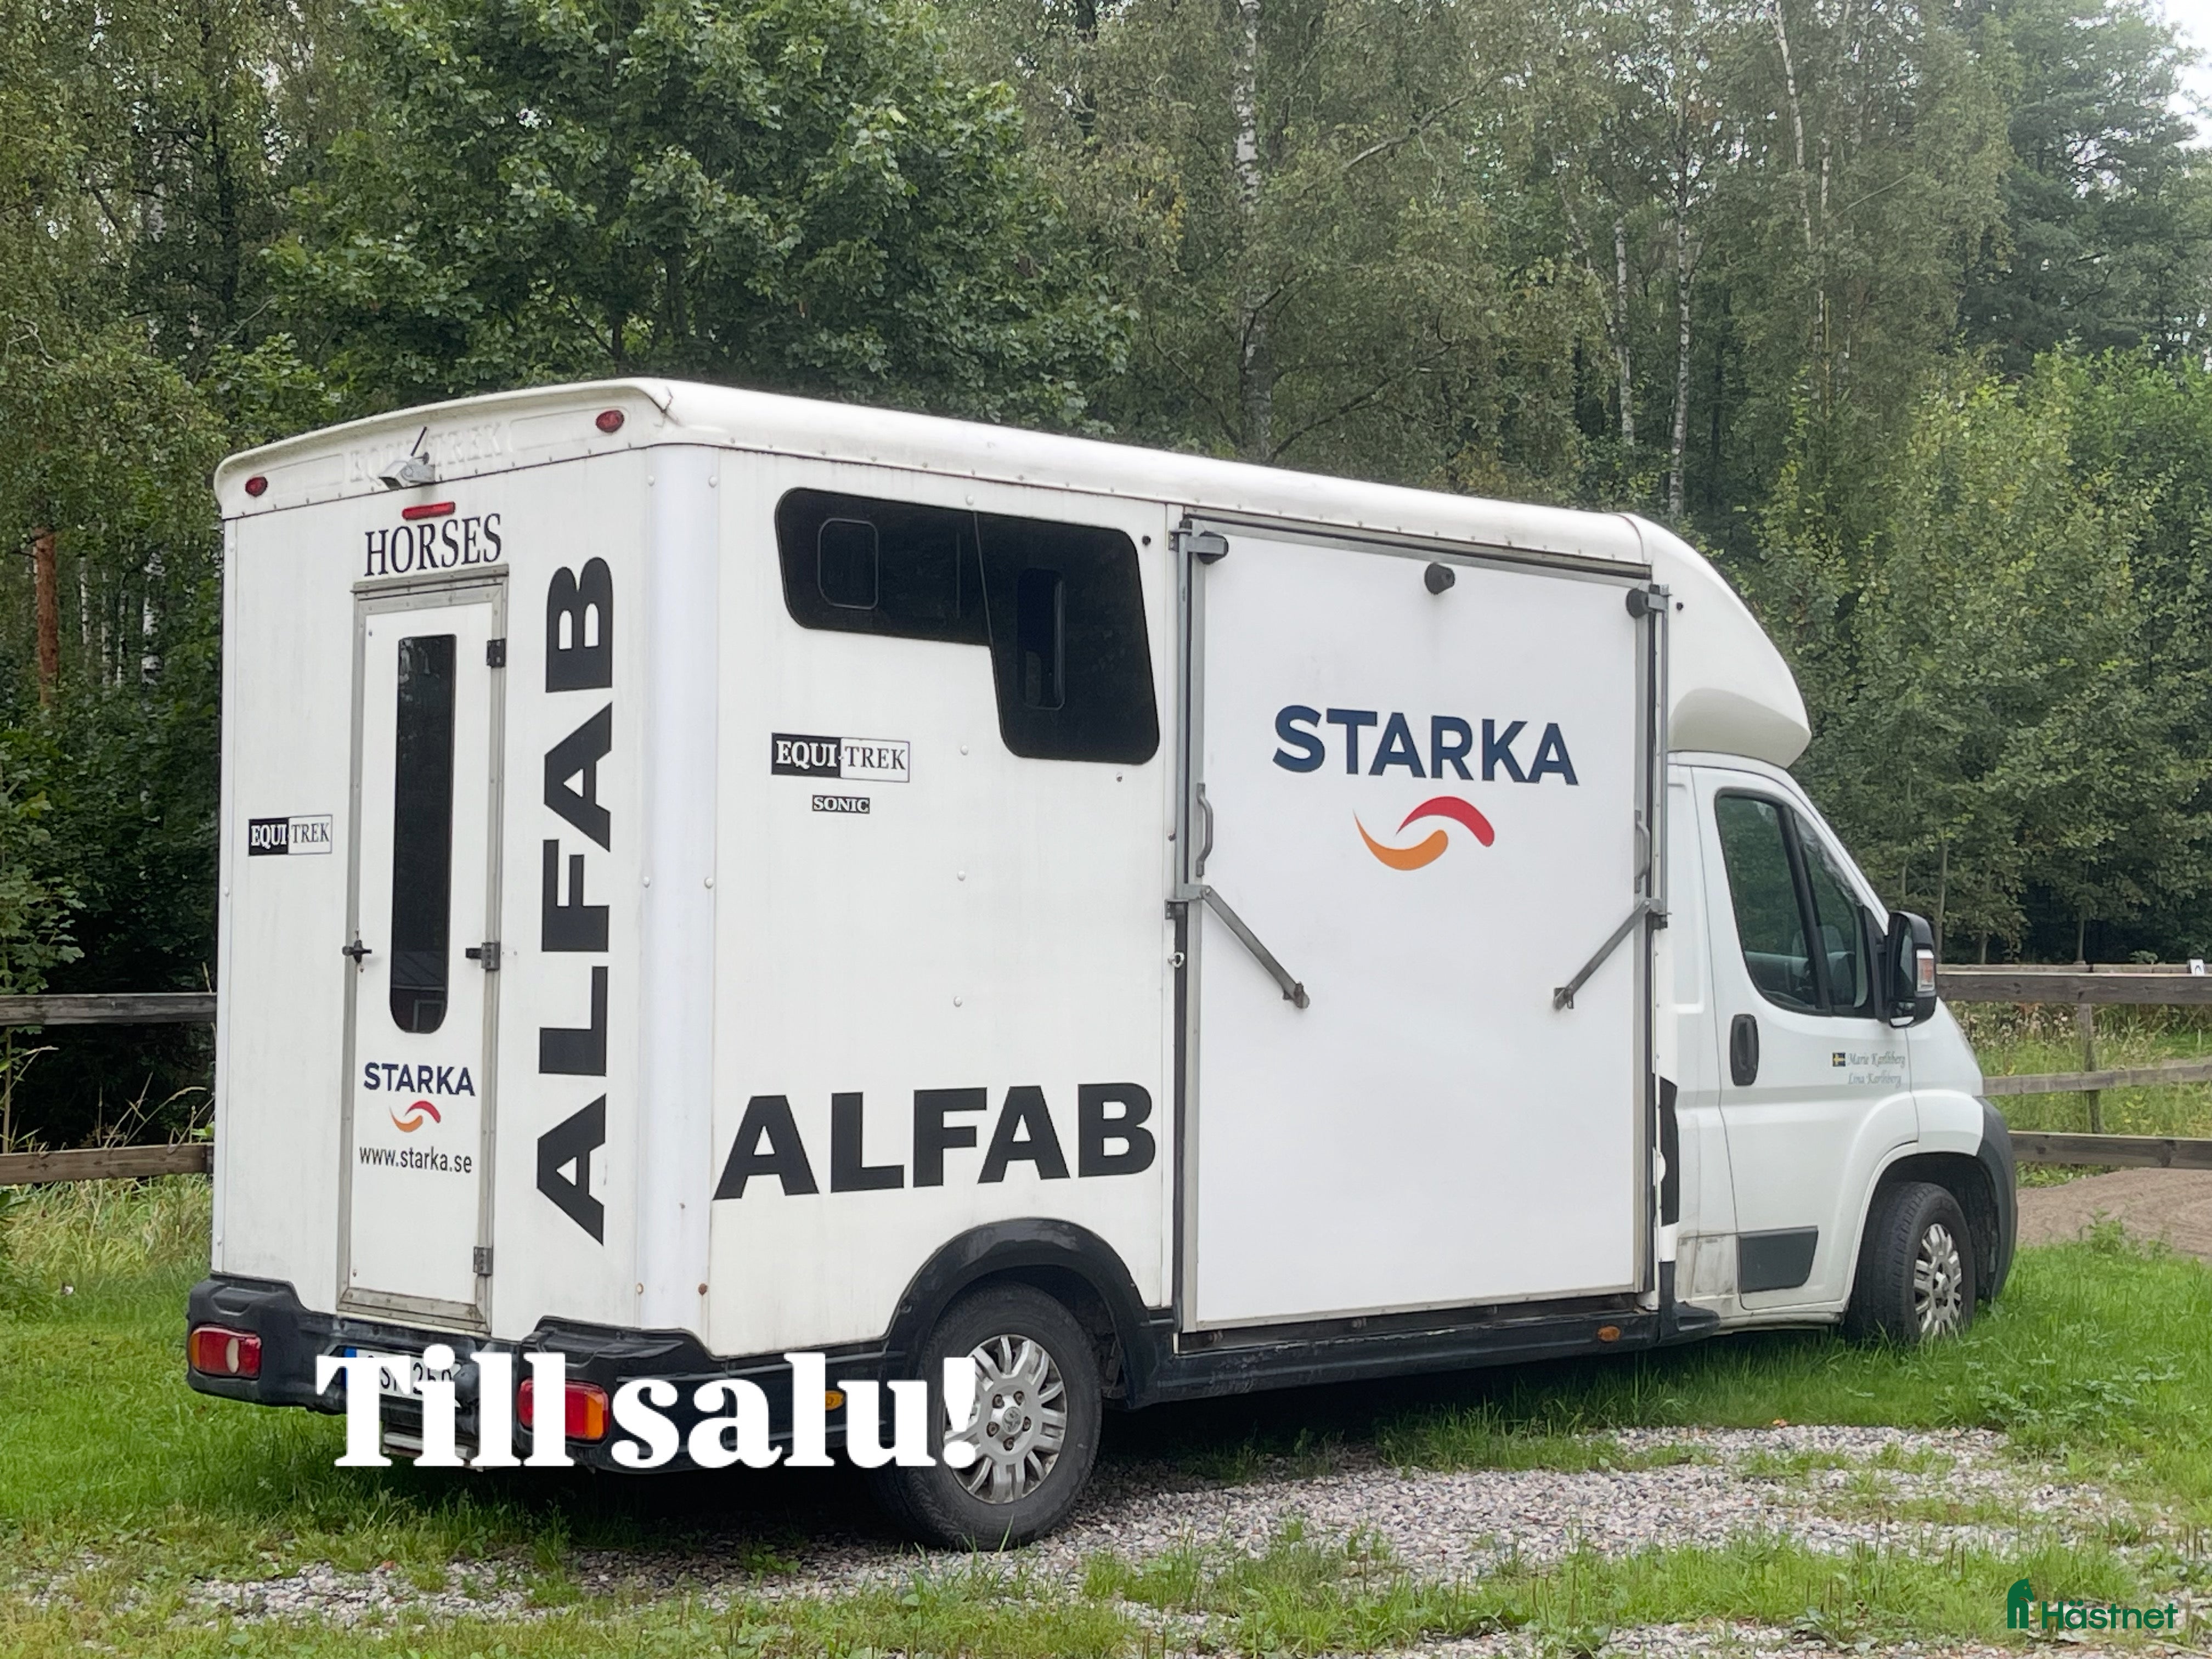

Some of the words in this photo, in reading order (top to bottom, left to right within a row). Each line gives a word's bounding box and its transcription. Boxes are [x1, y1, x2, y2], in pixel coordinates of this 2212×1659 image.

[364, 513, 501, 577] HORSES
[1272, 705, 1579, 786] STARKA
[813, 797, 869, 812] SONIC
[537, 557, 613, 1246] ALFAB
[364, 1062, 476, 1097] STARKA
[359, 1146, 472, 1173] www.starka.se
[712, 1082, 1156, 1201] ALFAB
